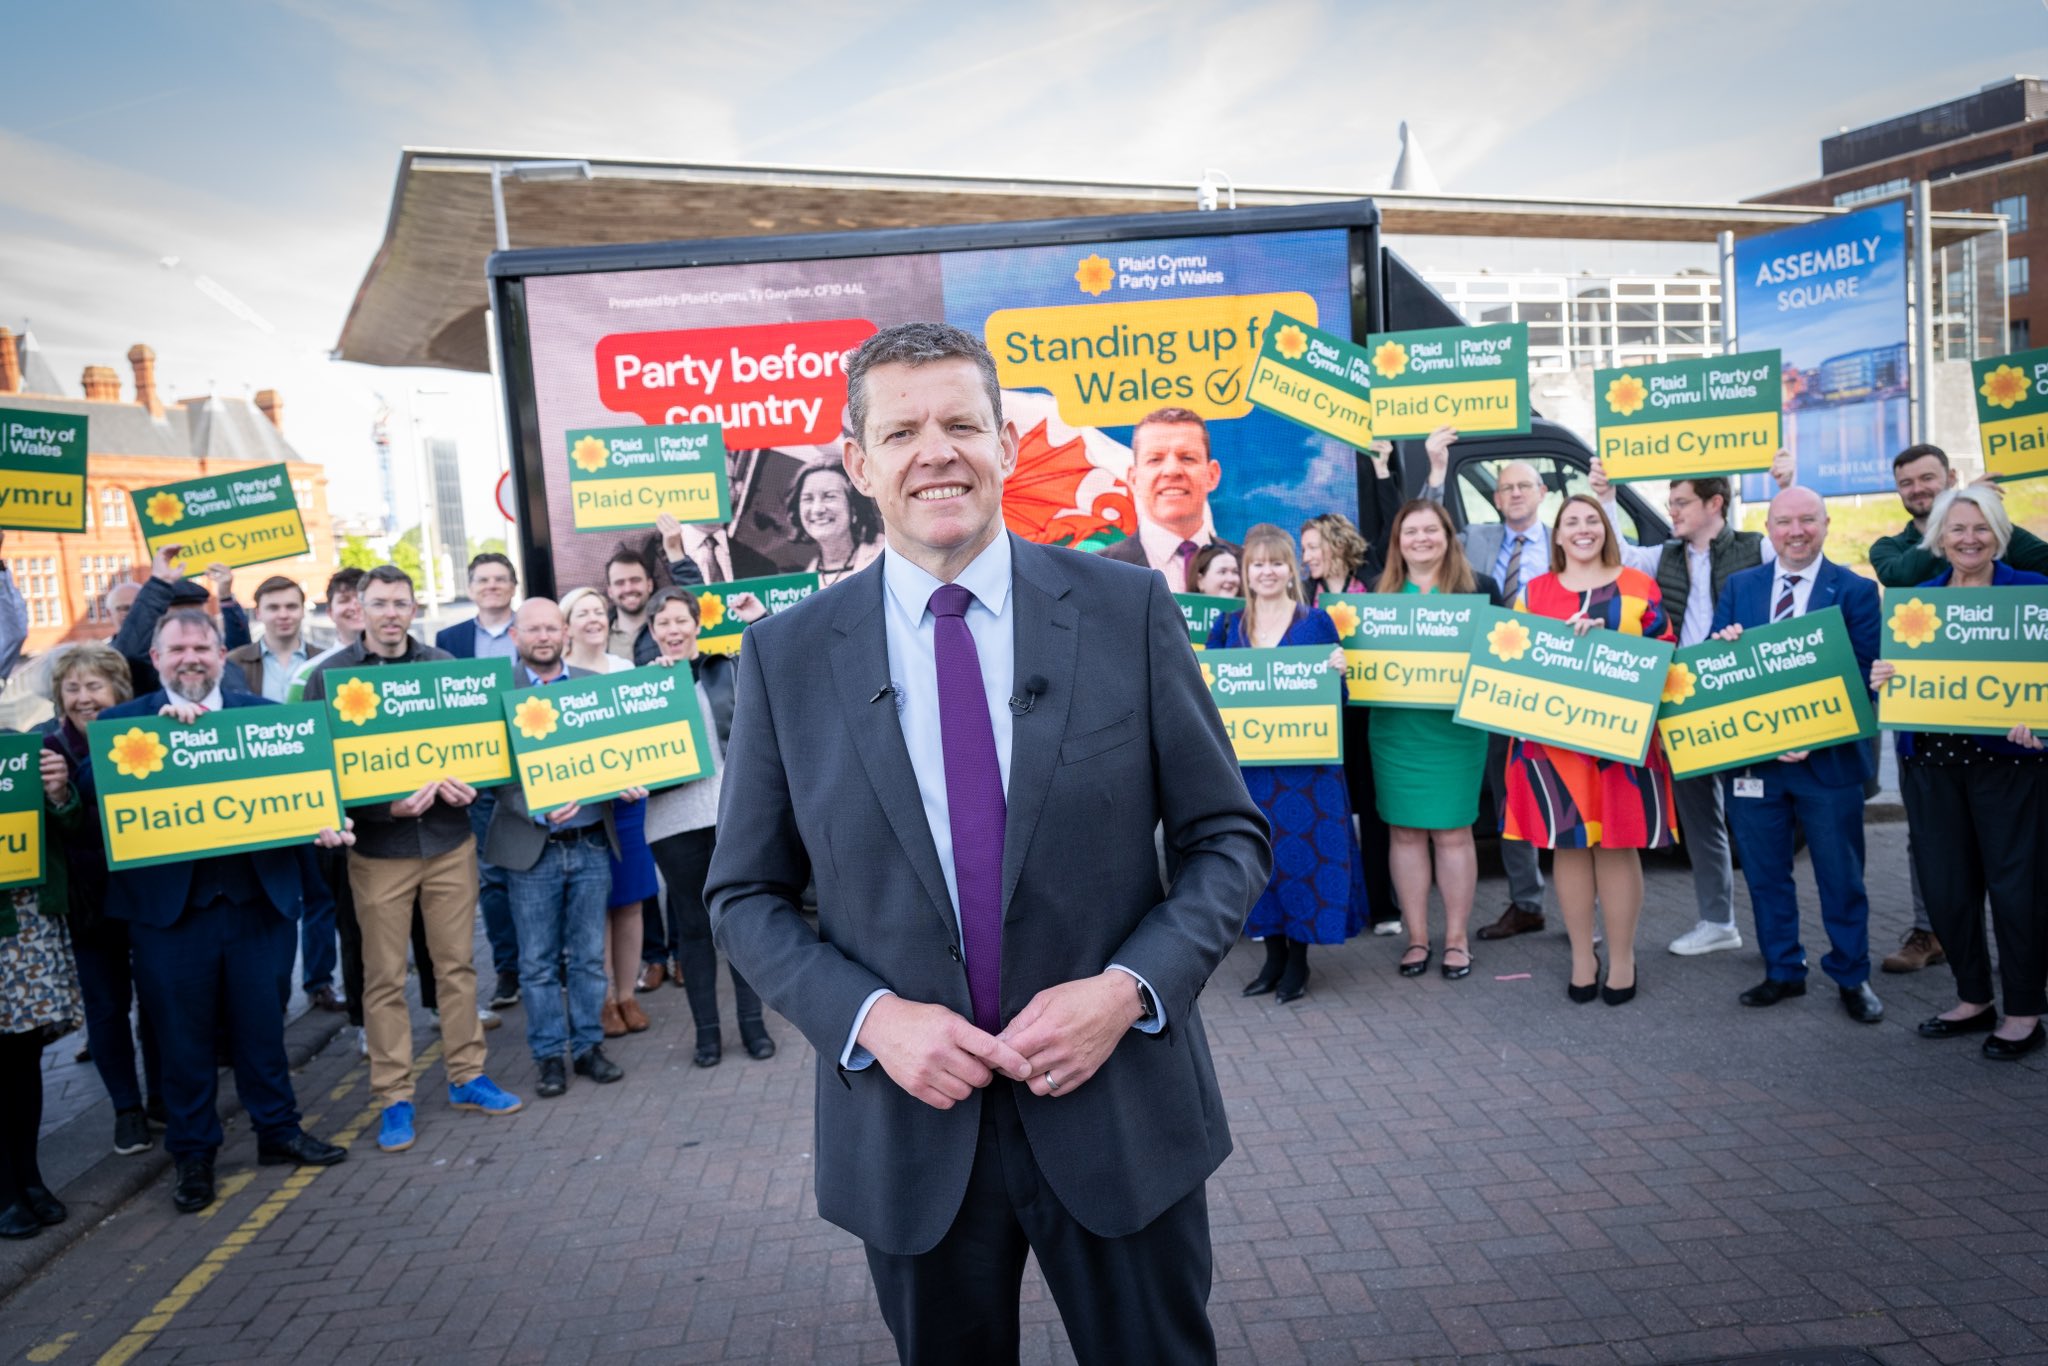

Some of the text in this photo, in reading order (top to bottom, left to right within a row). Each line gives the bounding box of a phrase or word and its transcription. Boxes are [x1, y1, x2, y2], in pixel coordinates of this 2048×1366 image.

[1118, 254, 1207, 273] Plaid Cymru
[1755, 235, 1881, 287] ASSEMBLY
[843, 282, 866, 295] 4AL
[1119, 269, 1224, 291] Party of Wales
[1777, 276, 1859, 311] SQUARE
[1005, 324, 1178, 365] Standing
[1188, 324, 1237, 361] up
[1310, 339, 1340, 361] Plaid
[1411, 336, 1512, 357] Plaid Party of
[614, 354, 722, 394] Party
[1306, 351, 1345, 377] Cymru
[1411, 353, 1502, 373] Cymru Wales
[1075, 369, 1194, 404] Wales
[1259, 369, 1311, 403] Plaid
[1650, 365, 1769, 391] Plaid Party of
[1376, 394, 1509, 417] Plaid Cymru
[1650, 385, 1757, 409] Cymru Wales
[665, 396, 823, 433] country
[10, 423, 76, 444] Party of
[610, 434, 709, 453] Plaid Party of
[1606, 430, 1768, 458] Plaid Cymru
[1988, 426, 2048, 456] Plai
[9, 439, 62, 457] Wales
[611, 449, 701, 467] Cymru Wales
[0, 487, 72, 509] ymru
[183, 474, 282, 504] Plaid Party of
[578, 487, 710, 509] Plaid Cymru
[187, 490, 277, 517] Cymru Wales
[156, 537, 215, 560] aid
[219, 524, 295, 551] Cymru
[770, 588, 800, 601] Party
[1363, 607, 1471, 623] Plaid Party of
[1947, 605, 1993, 622] Plaid
[1362, 621, 1459, 638] Cymru Wales
[1945, 623, 2010, 644] Cymru
[1535, 631, 1658, 670] Plaid Party of
[1696, 628, 1825, 674] Plaid Party of
[1217, 660, 1328, 678] Plaid Party of
[1345, 661, 1463, 687] aid Cymru
[1531, 646, 1639, 683] Cymru Wales
[1700, 651, 1817, 691] Cymru Wales
[382, 673, 496, 698] Plaid Party of
[560, 677, 675, 711] Plaid Party of
[1218, 676, 1318, 695] Cymru Wales
[1887, 674, 2048, 708] Plaid Cym
[383, 692, 487, 717] Cymru Wales
[563, 697, 668, 728] Cymru Wales
[1470, 678, 1639, 735] Plaid Cymru
[170, 719, 315, 749] Plaid Party of
[1243, 719, 1328, 744] Cymru
[1668, 715, 1739, 751] Plaid
[1743, 696, 1842, 733] Cymru
[8, 753, 29, 772] of
[172, 739, 305, 769] Cymru Wales
[342, 739, 500, 775] Plaid Cymru
[527, 754, 595, 786] Plaid
[601, 738, 686, 770] Cymru
[115, 800, 205, 834] Plaid
[213, 790, 325, 823] Cymru
